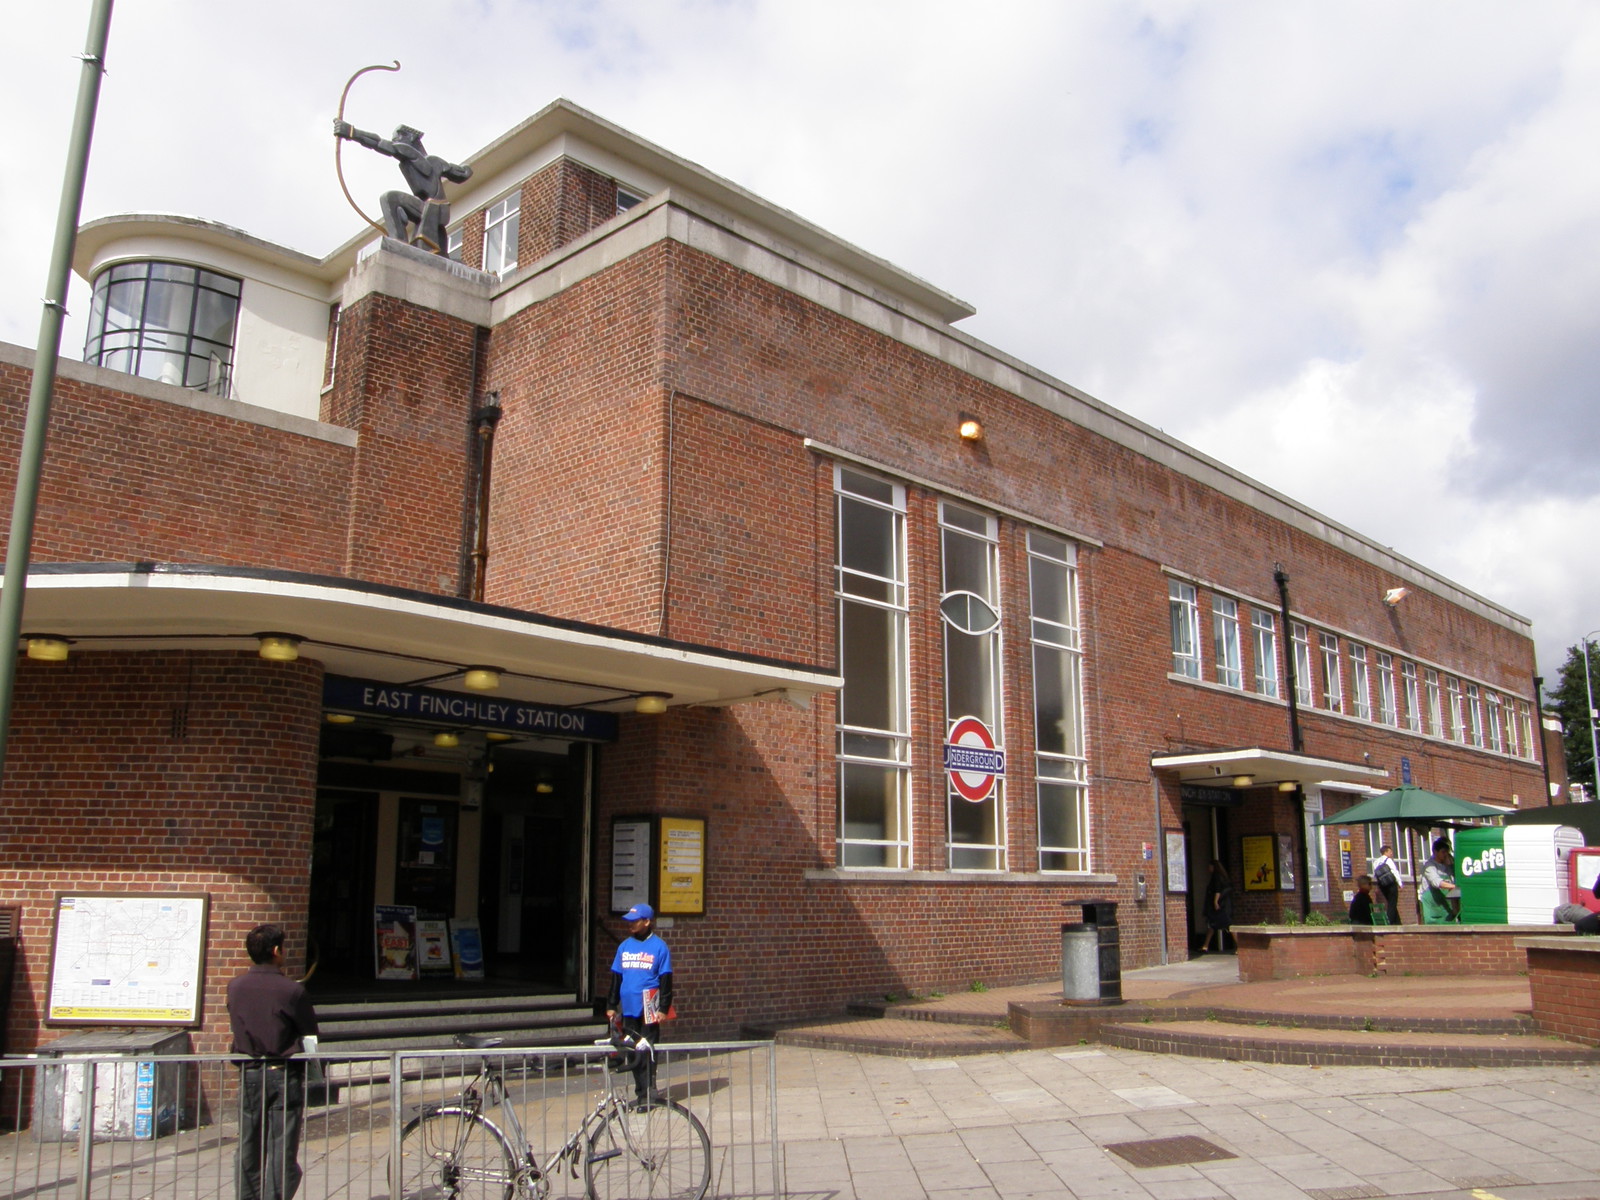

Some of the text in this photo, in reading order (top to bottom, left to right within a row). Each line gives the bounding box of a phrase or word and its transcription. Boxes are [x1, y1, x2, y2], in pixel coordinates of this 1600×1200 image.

[363, 687, 585, 732] EAST FINCHLEY STATION
[944, 749, 1004, 770] UNDERGROUND
